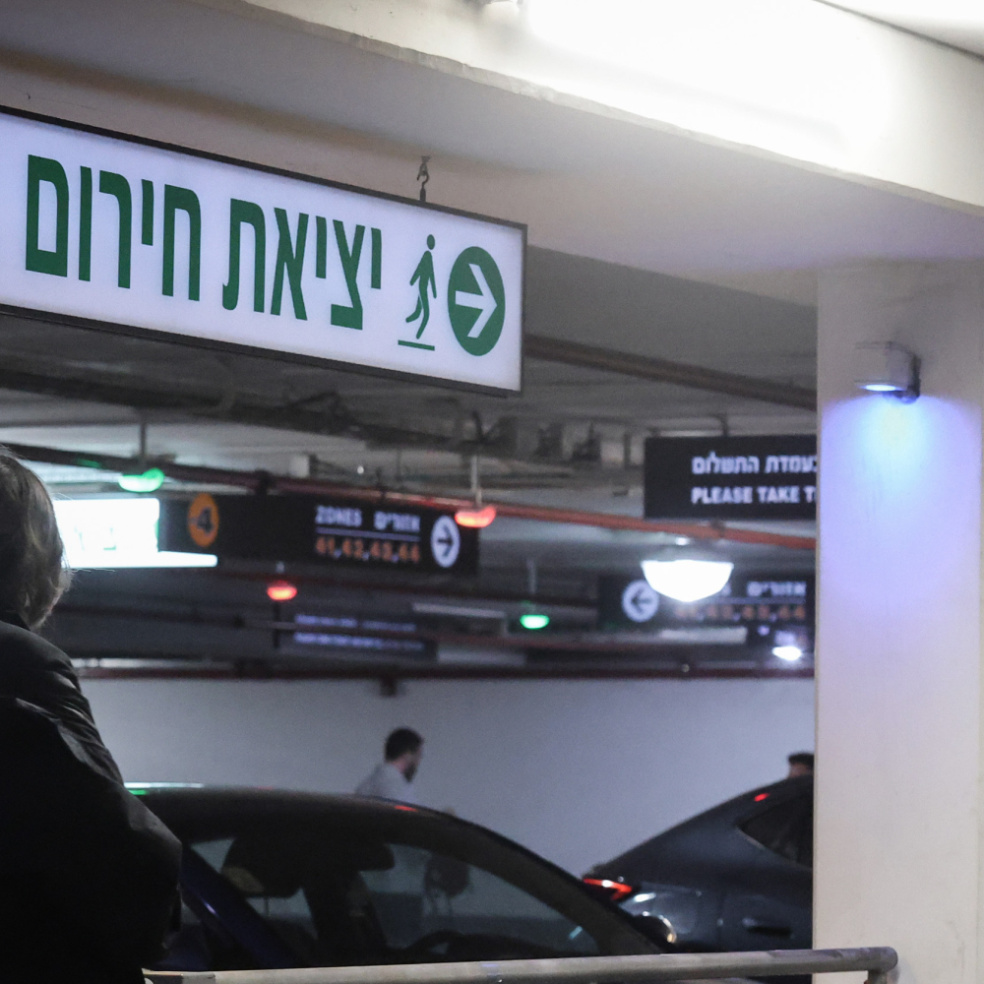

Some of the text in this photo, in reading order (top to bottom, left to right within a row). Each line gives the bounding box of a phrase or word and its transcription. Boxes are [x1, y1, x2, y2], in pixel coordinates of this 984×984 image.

[25, 154, 382, 331] יציאת חירום
[691, 485, 817, 505] PLEASE TAKE T
